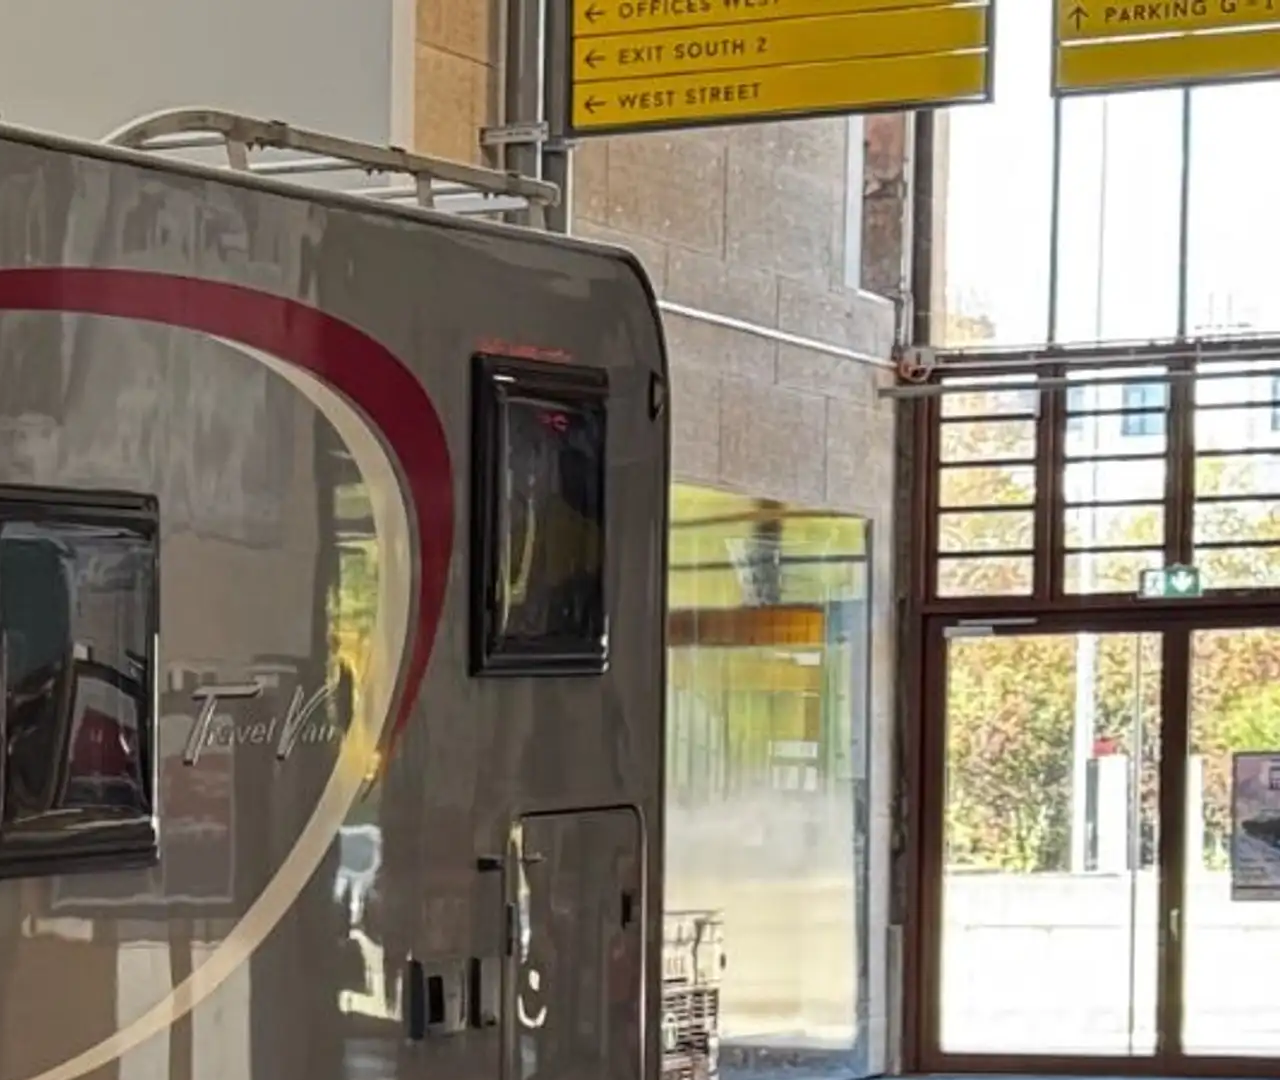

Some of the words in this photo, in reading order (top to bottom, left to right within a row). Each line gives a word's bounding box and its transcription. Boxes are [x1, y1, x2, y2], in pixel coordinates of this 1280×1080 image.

[618, 0, 711, 19] OFFICES
[1104, 0, 1207, 24] PARKING
[618, 46, 663, 65] EXIT
[674, 38, 745, 60] SOUTH
[756, 37, 768, 53] 2
[618, 90, 676, 110] WEST
[685, 82, 762, 105] STREET
